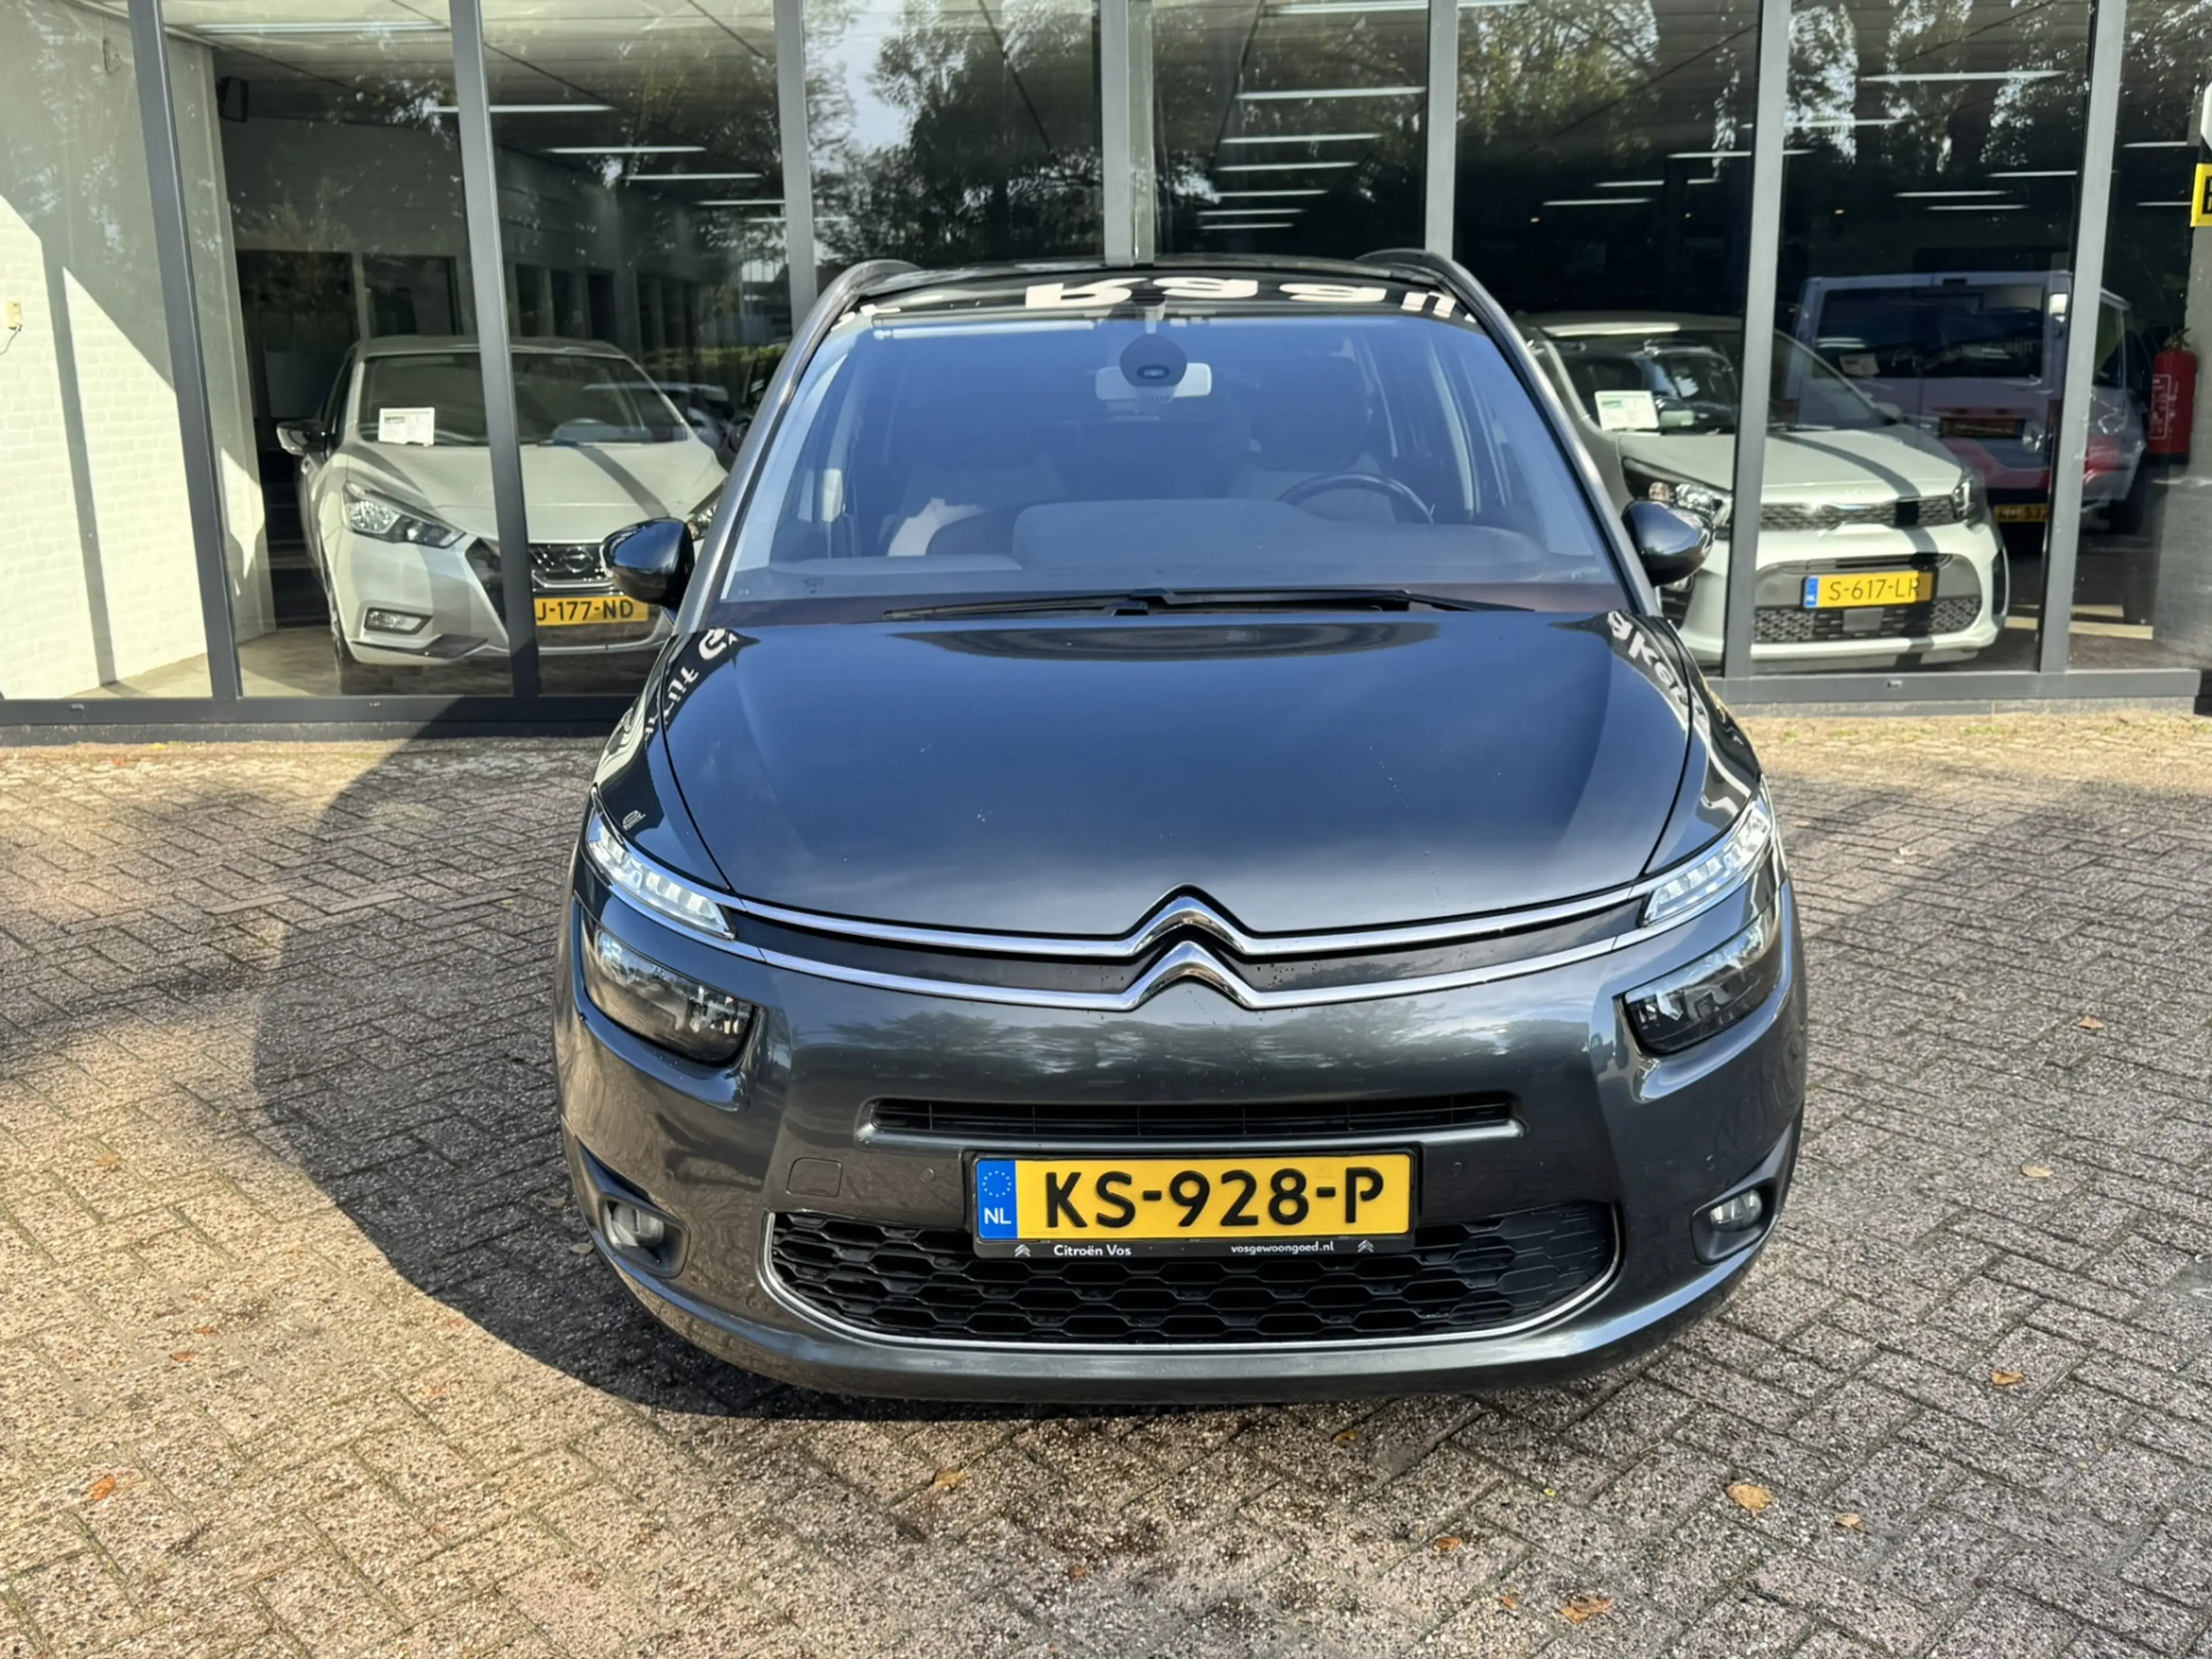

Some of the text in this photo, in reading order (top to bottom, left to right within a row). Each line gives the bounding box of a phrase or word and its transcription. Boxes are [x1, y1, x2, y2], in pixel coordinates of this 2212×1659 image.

[1828, 577, 1921, 601] S-617-LR
[537, 599, 634, 621] J-177-ND
[1045, 1167, 1384, 1228] KS-928-P
[984, 1207, 1012, 1225] NL
[1053, 1244, 1132, 1257] Citroën Vos
[1230, 1240, 1335, 1255] vosgewoongoed.nl
